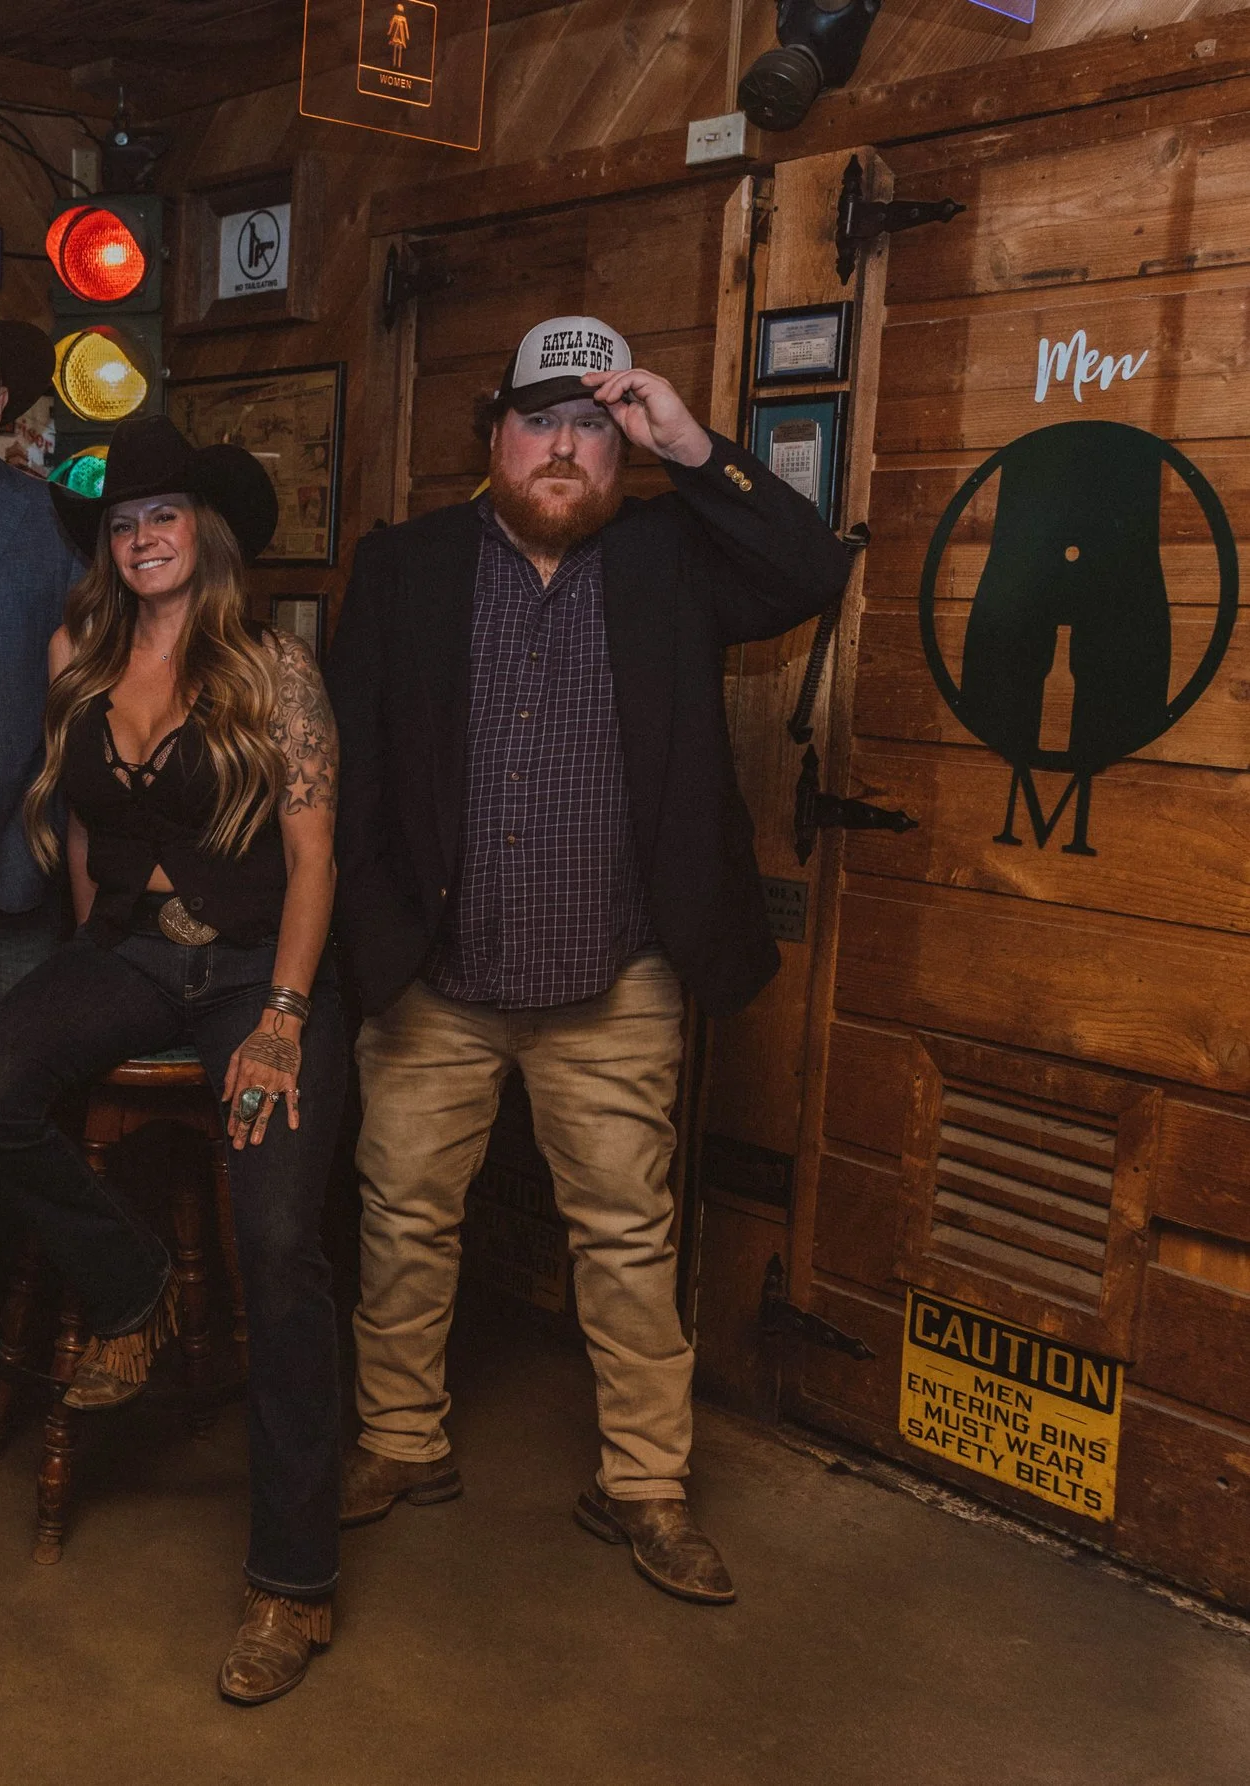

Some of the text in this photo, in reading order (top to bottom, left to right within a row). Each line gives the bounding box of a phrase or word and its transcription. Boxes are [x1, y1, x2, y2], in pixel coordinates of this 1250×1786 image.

[379, 74, 412, 88] WOMEN
[235, 279, 278, 292] NO TAILGATING
[539, 350, 612, 372] MADE ME DO IT
[542, 331, 614, 355] KAYLA JANE
[1034, 329, 1148, 402] Men
[993, 762, 1098, 857] M
[915, 1302, 1109, 1405] CAUTION
[907, 1372, 1106, 1464] ENTERING BINS
[973, 1376, 1033, 1412] MEN
[907, 1417, 1102, 1511] SAFETY BELTS
[924, 1401, 1084, 1480] MUST WEAR
